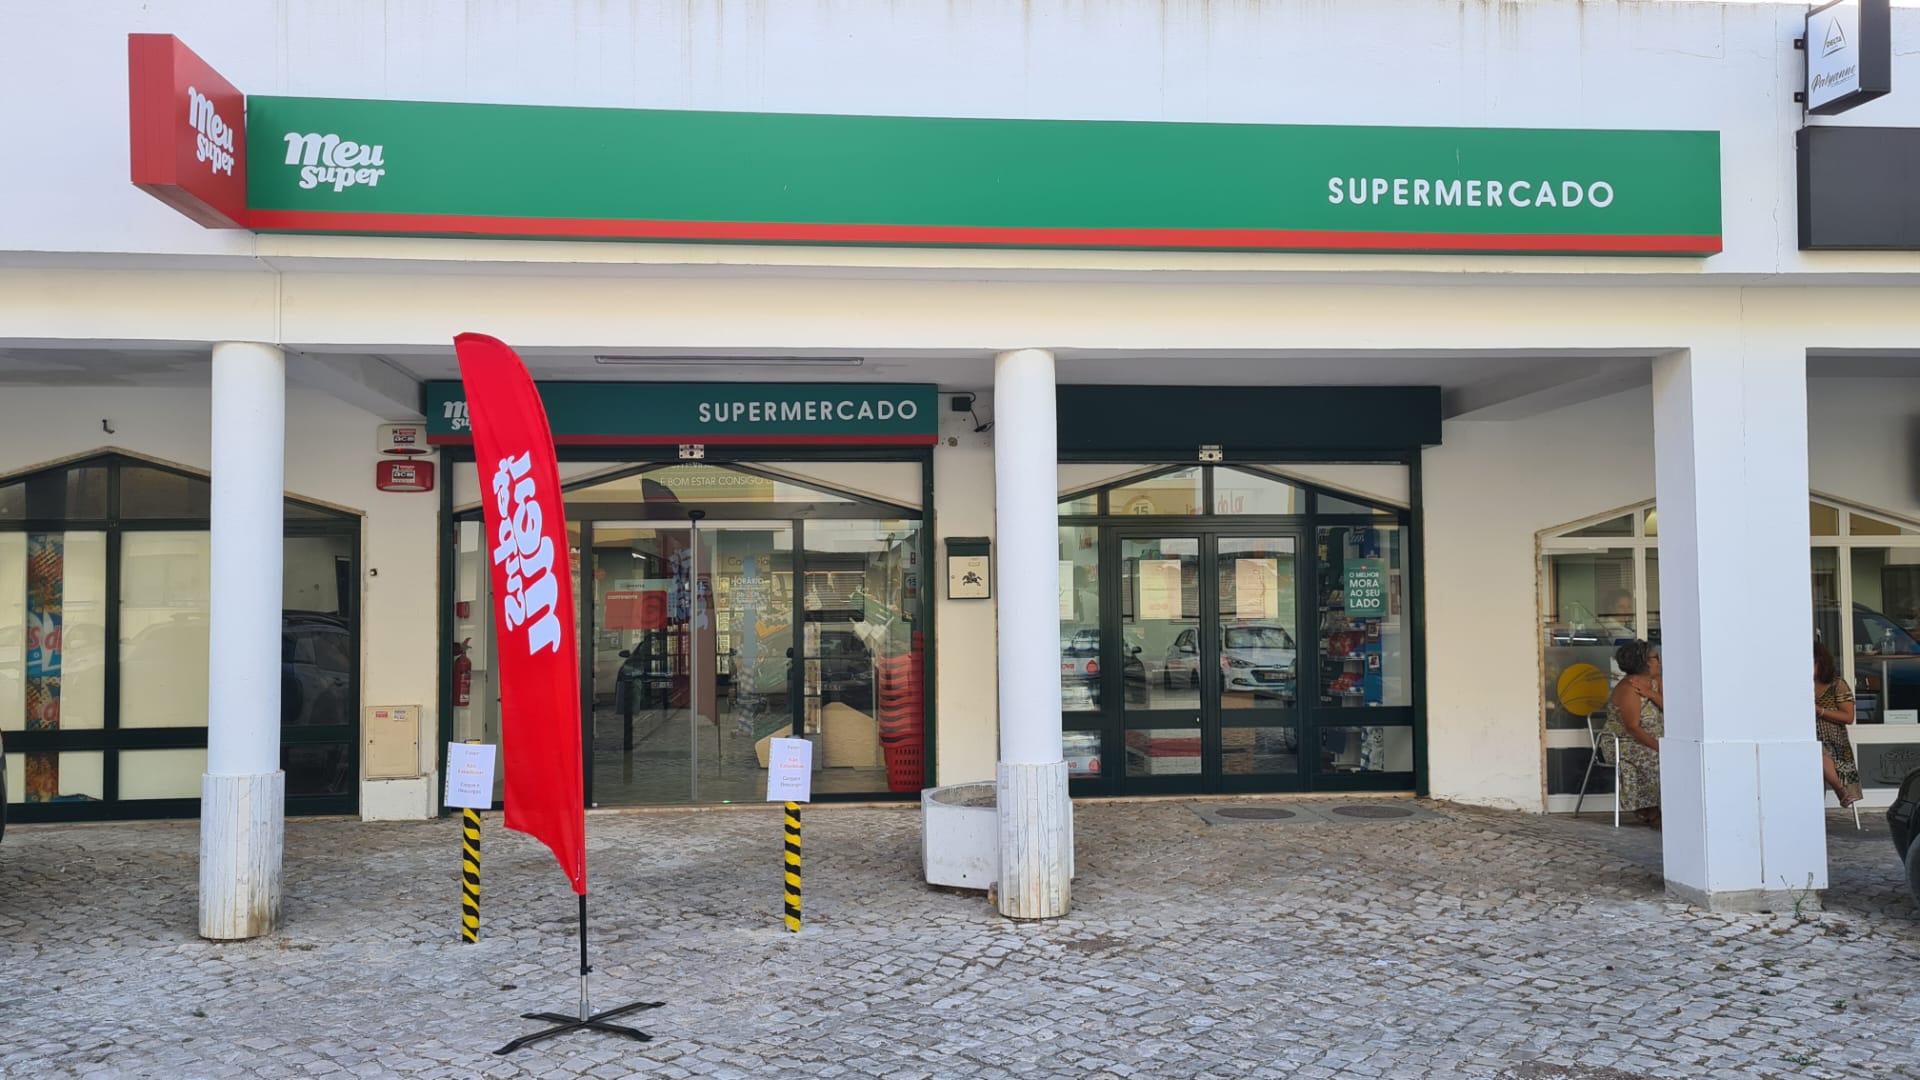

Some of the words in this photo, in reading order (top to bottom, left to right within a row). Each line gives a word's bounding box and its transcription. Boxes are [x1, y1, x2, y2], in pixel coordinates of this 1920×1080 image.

[196, 133, 234, 176] super
[299, 165, 385, 192] super
[1328, 177, 1614, 208] SUPERMERCADO
[699, 400, 918, 422] SUPERMERCADO
[492, 458, 526, 632] super
[1350, 580, 1379, 588] MORA
[1350, 599, 1381, 609] LADO
